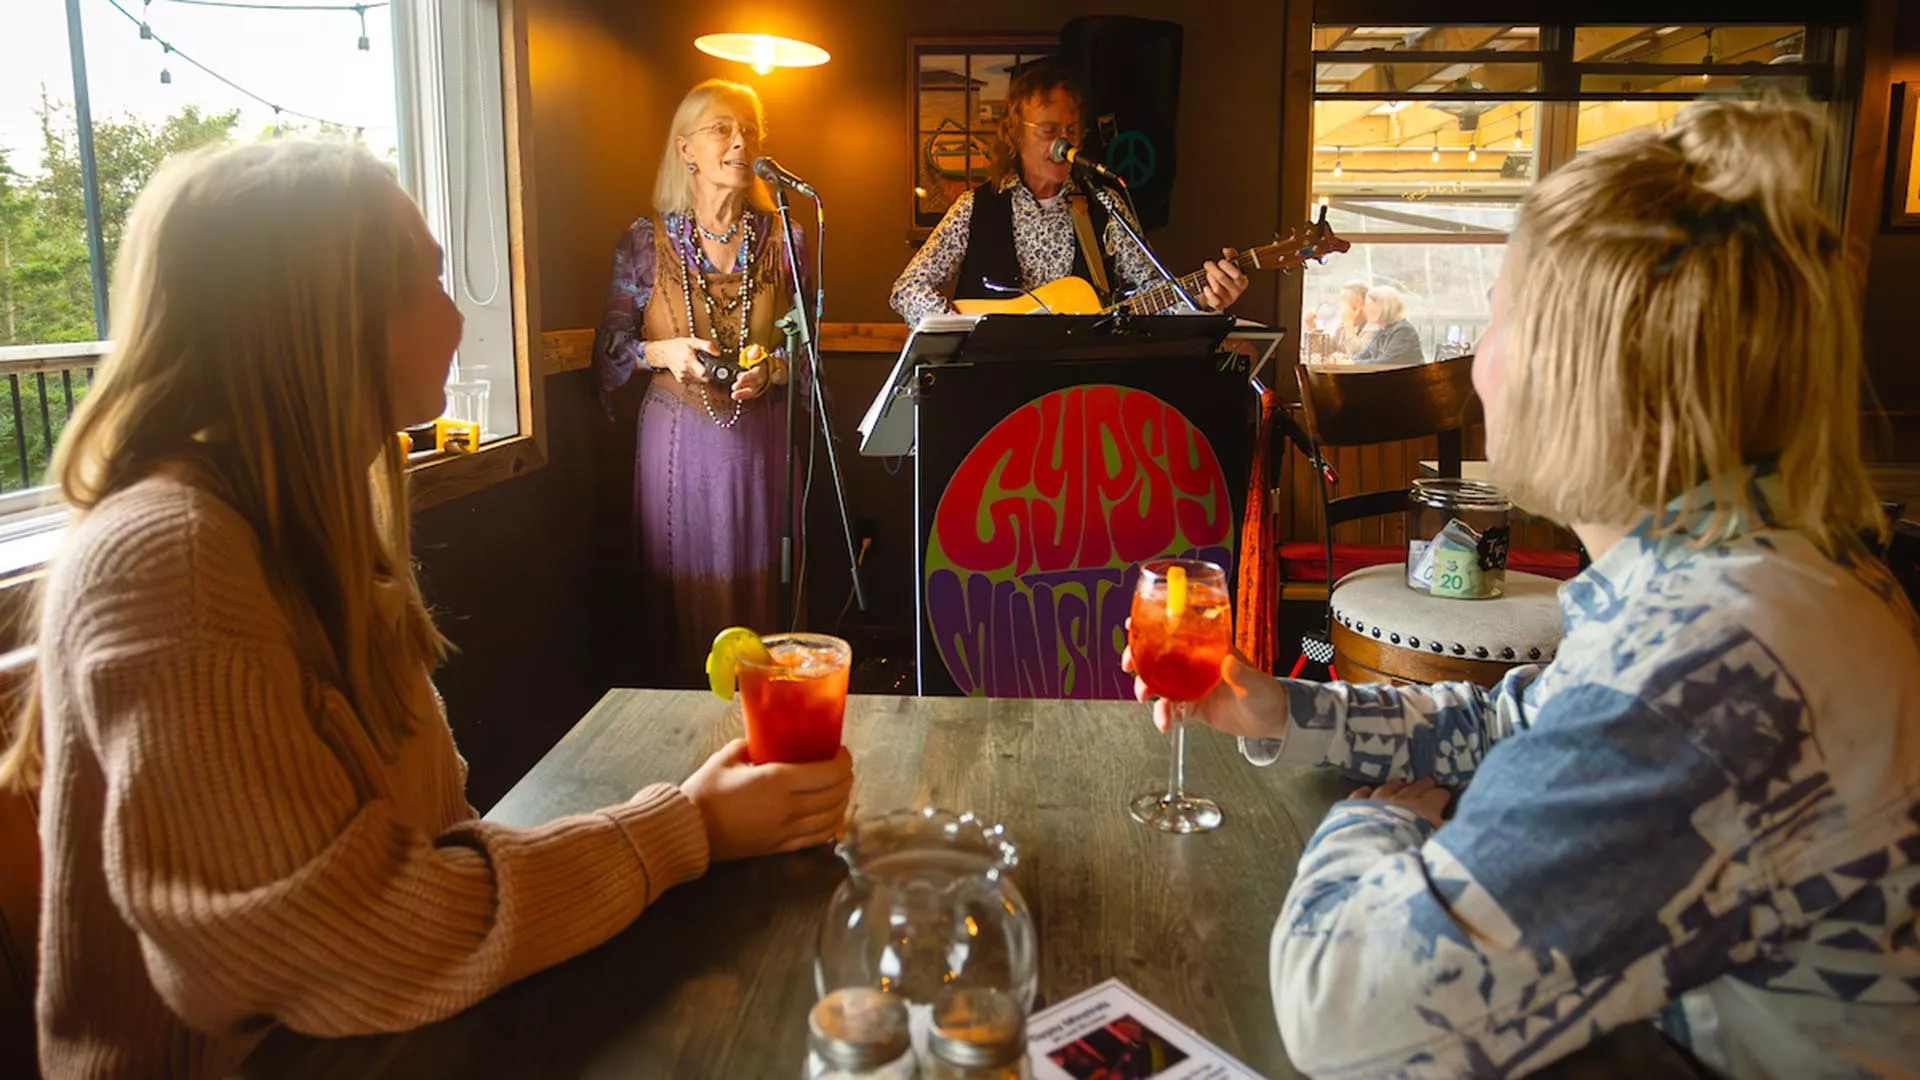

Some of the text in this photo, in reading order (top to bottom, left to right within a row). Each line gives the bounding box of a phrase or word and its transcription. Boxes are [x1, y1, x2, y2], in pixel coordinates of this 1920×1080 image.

[937, 386, 1230, 576] GYPSY
[928, 547, 1232, 698] MINSTR
[1440, 574, 1463, 590] 20
